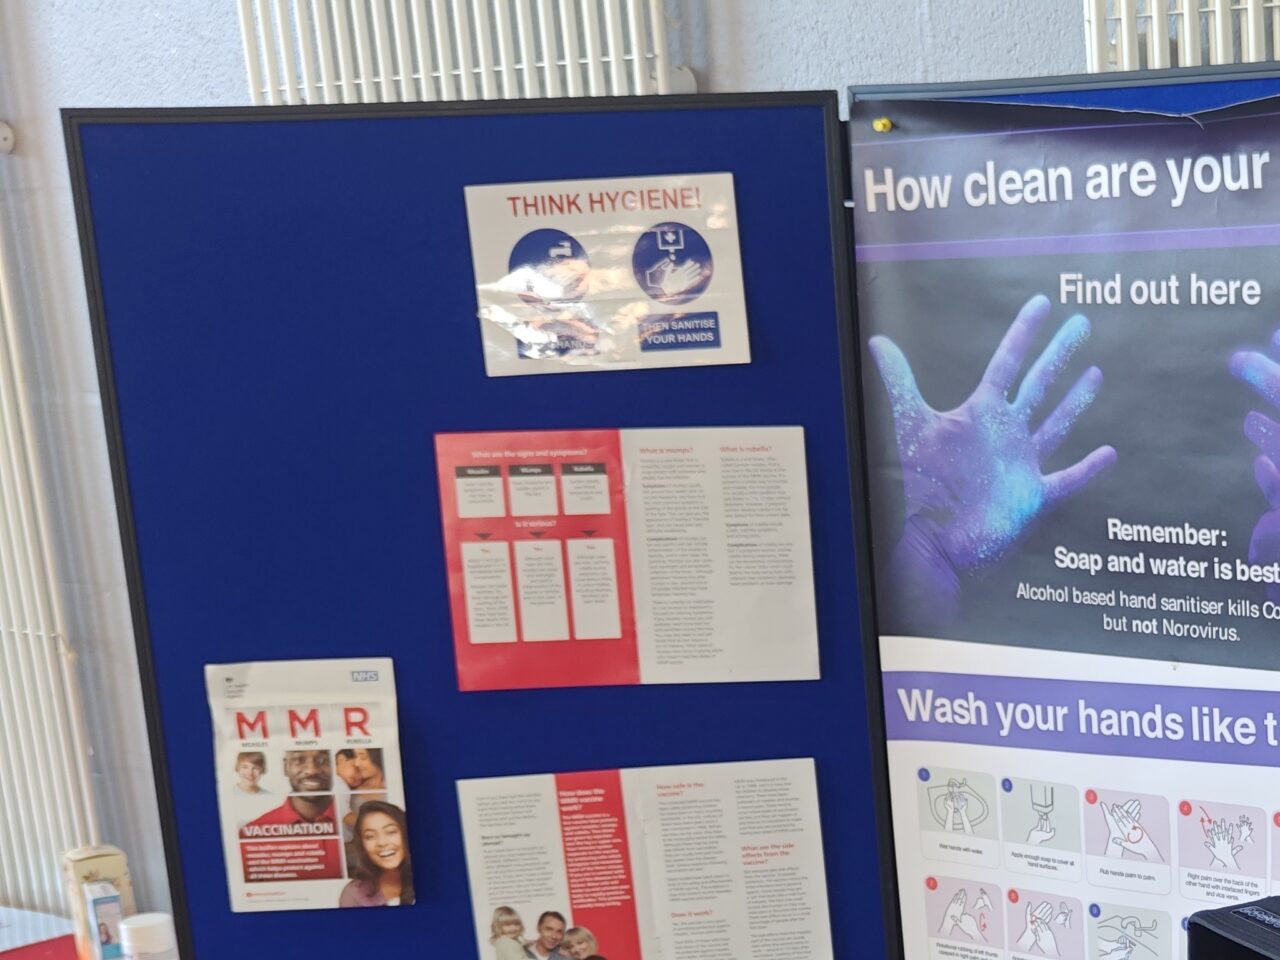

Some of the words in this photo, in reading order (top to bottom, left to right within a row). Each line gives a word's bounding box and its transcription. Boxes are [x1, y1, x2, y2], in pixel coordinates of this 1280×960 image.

[863, 167, 952, 212] How
[964, 160, 1073, 206] clean
[1085, 159, 1156, 199] are
[1169, 150, 1271, 209] your
[507, 194, 582, 217] THINK
[588, 187, 702, 212] HYGIENE!
[1060, 272, 1122, 306] Find
[1130, 275, 1179, 306] out
[1191, 273, 1261, 306] here
[647, 335, 676, 344] YOUR
[678, 333, 713, 342] HANDS
[671, 320, 715, 329] SANITISE
[1107, 518, 1228, 548] Remember:
[1054, 546, 1102, 575] Soap
[1108, 552, 1145, 574] and
[1149, 556, 1208, 579] water
[1214, 559, 1232, 580] is
[1017, 582, 1068, 603] Alcohol
[1073, 587, 1115, 607] based
[1120, 591, 1157, 609] hand
[1161, 595, 1223, 616] sanitiser
[1228, 598, 1259, 618] kills
[1103, 613, 1127, 632] but
[1132, 617, 1158, 634] not
[1162, 619, 1240, 642] Norovirus.
[353, 671, 378, 681] NHS
[235, 710, 269, 740] M
[288, 708, 321, 738] M
[344, 707, 372, 737] R
[898, 689, 988, 726] Wash
[997, 698, 1068, 737] your
[1078, 699, 1184, 742] hands
[1191, 706, 1256, 746] like
[244, 822, 334, 837] VACCINATION
